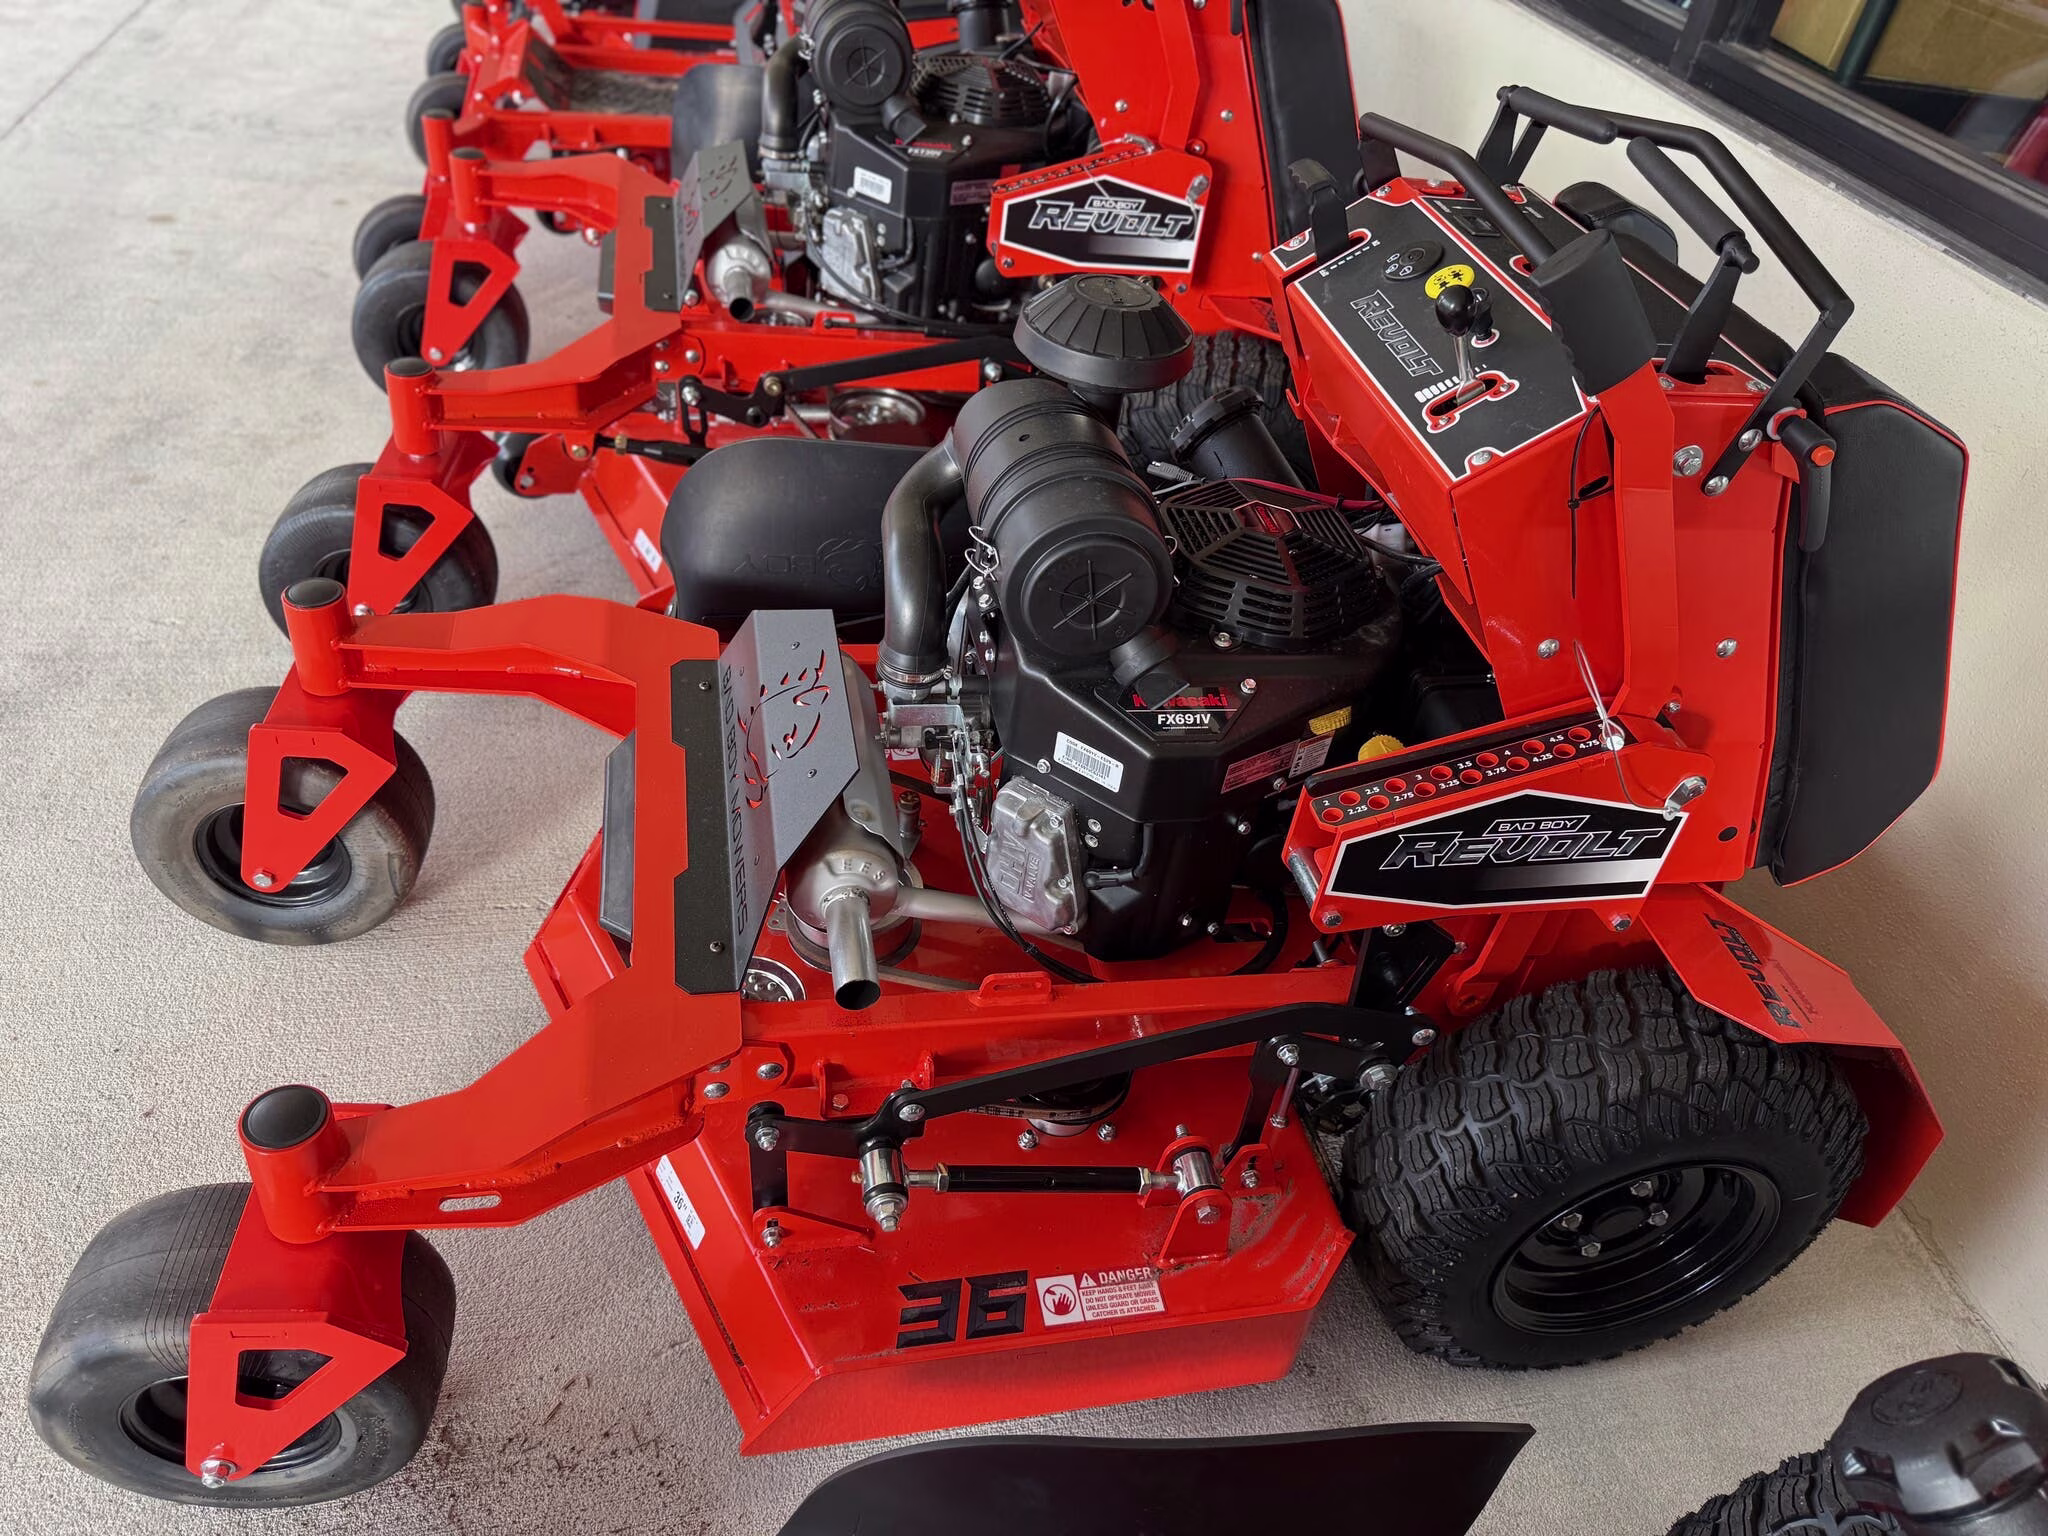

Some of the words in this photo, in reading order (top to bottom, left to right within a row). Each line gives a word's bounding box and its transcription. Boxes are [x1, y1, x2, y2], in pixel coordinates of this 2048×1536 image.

[1028, 200, 1193, 238] REVOLT
[1350, 289, 1444, 377] REVOLT
[722, 664, 734, 724] BAD
[1157, 713, 1211, 725] FX691V
[1549, 734, 1564, 743] 4.5
[1579, 739, 1600, 750] 4.75
[726, 725, 738, 783] BOY
[1504, 749, 1512, 757] 4
[1532, 752, 1553, 763] 4.25
[1457, 760, 1473, 769] 3.5
[1485, 766, 1507, 776] 3.75
[1439, 779, 1460, 789] 3.25
[1365, 786, 1380, 795] 2.5
[1393, 791, 1415, 802] 2.75
[1322, 799, 1330, 807] 2
[1347, 805, 1368, 815] 2.25
[1498, 822, 1535, 832] BAD
[1540, 819, 1577, 830] BOY
[1380, 828, 1666, 870] REVOLT
[731, 787, 748, 936] MOWERS
[1704, 912, 1803, 1029] REVOLT
[1098, 1267, 1153, 1284] DANGER
[1081, 1288, 1096, 1297] KEEP
[1097, 1287, 1117, 1295] HANDS
[1123, 1284, 1137, 1292] FEET
[1094, 1295, 1107, 1303] NOT
[1107, 1292, 1134, 1300] OPERATE
[1134, 1289, 1157, 1298] MOWER
[896, 1270, 1029, 1349] 36
[1085, 1303, 1108, 1311] UNLESS
[1109, 1300, 1129, 1308] GUARD
[1140, 1296, 1160, 1305] GRASS
[1091, 1309, 1118, 1318] CATCHER
[1119, 1307, 1126, 1315] IS
